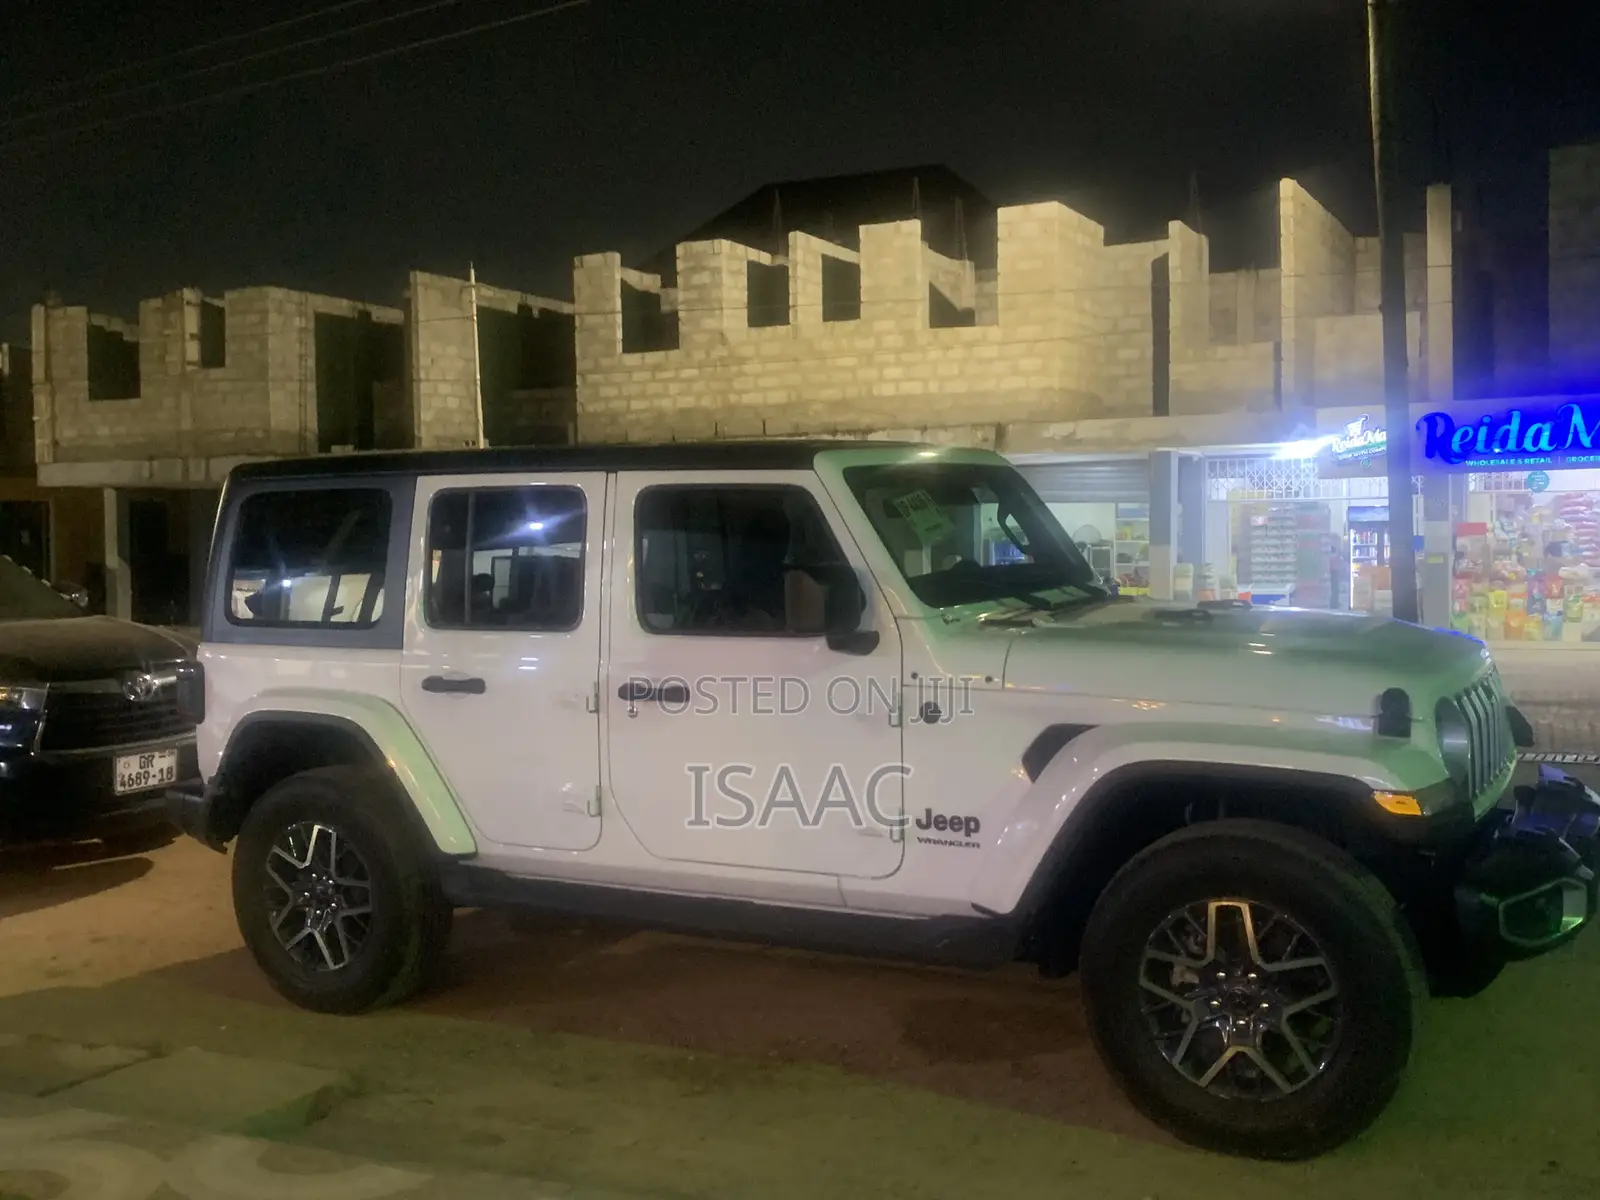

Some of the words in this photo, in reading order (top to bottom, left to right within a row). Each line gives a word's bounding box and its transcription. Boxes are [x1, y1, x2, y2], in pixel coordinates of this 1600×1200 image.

[1465, 458, 1516, 467] WHOLESALE
[1524, 457, 1552, 465] RETAIL
[139, 754, 155, 769] GR
[915, 807, 981, 837] Jeep
[916, 836, 981, 849] WRANGLER
